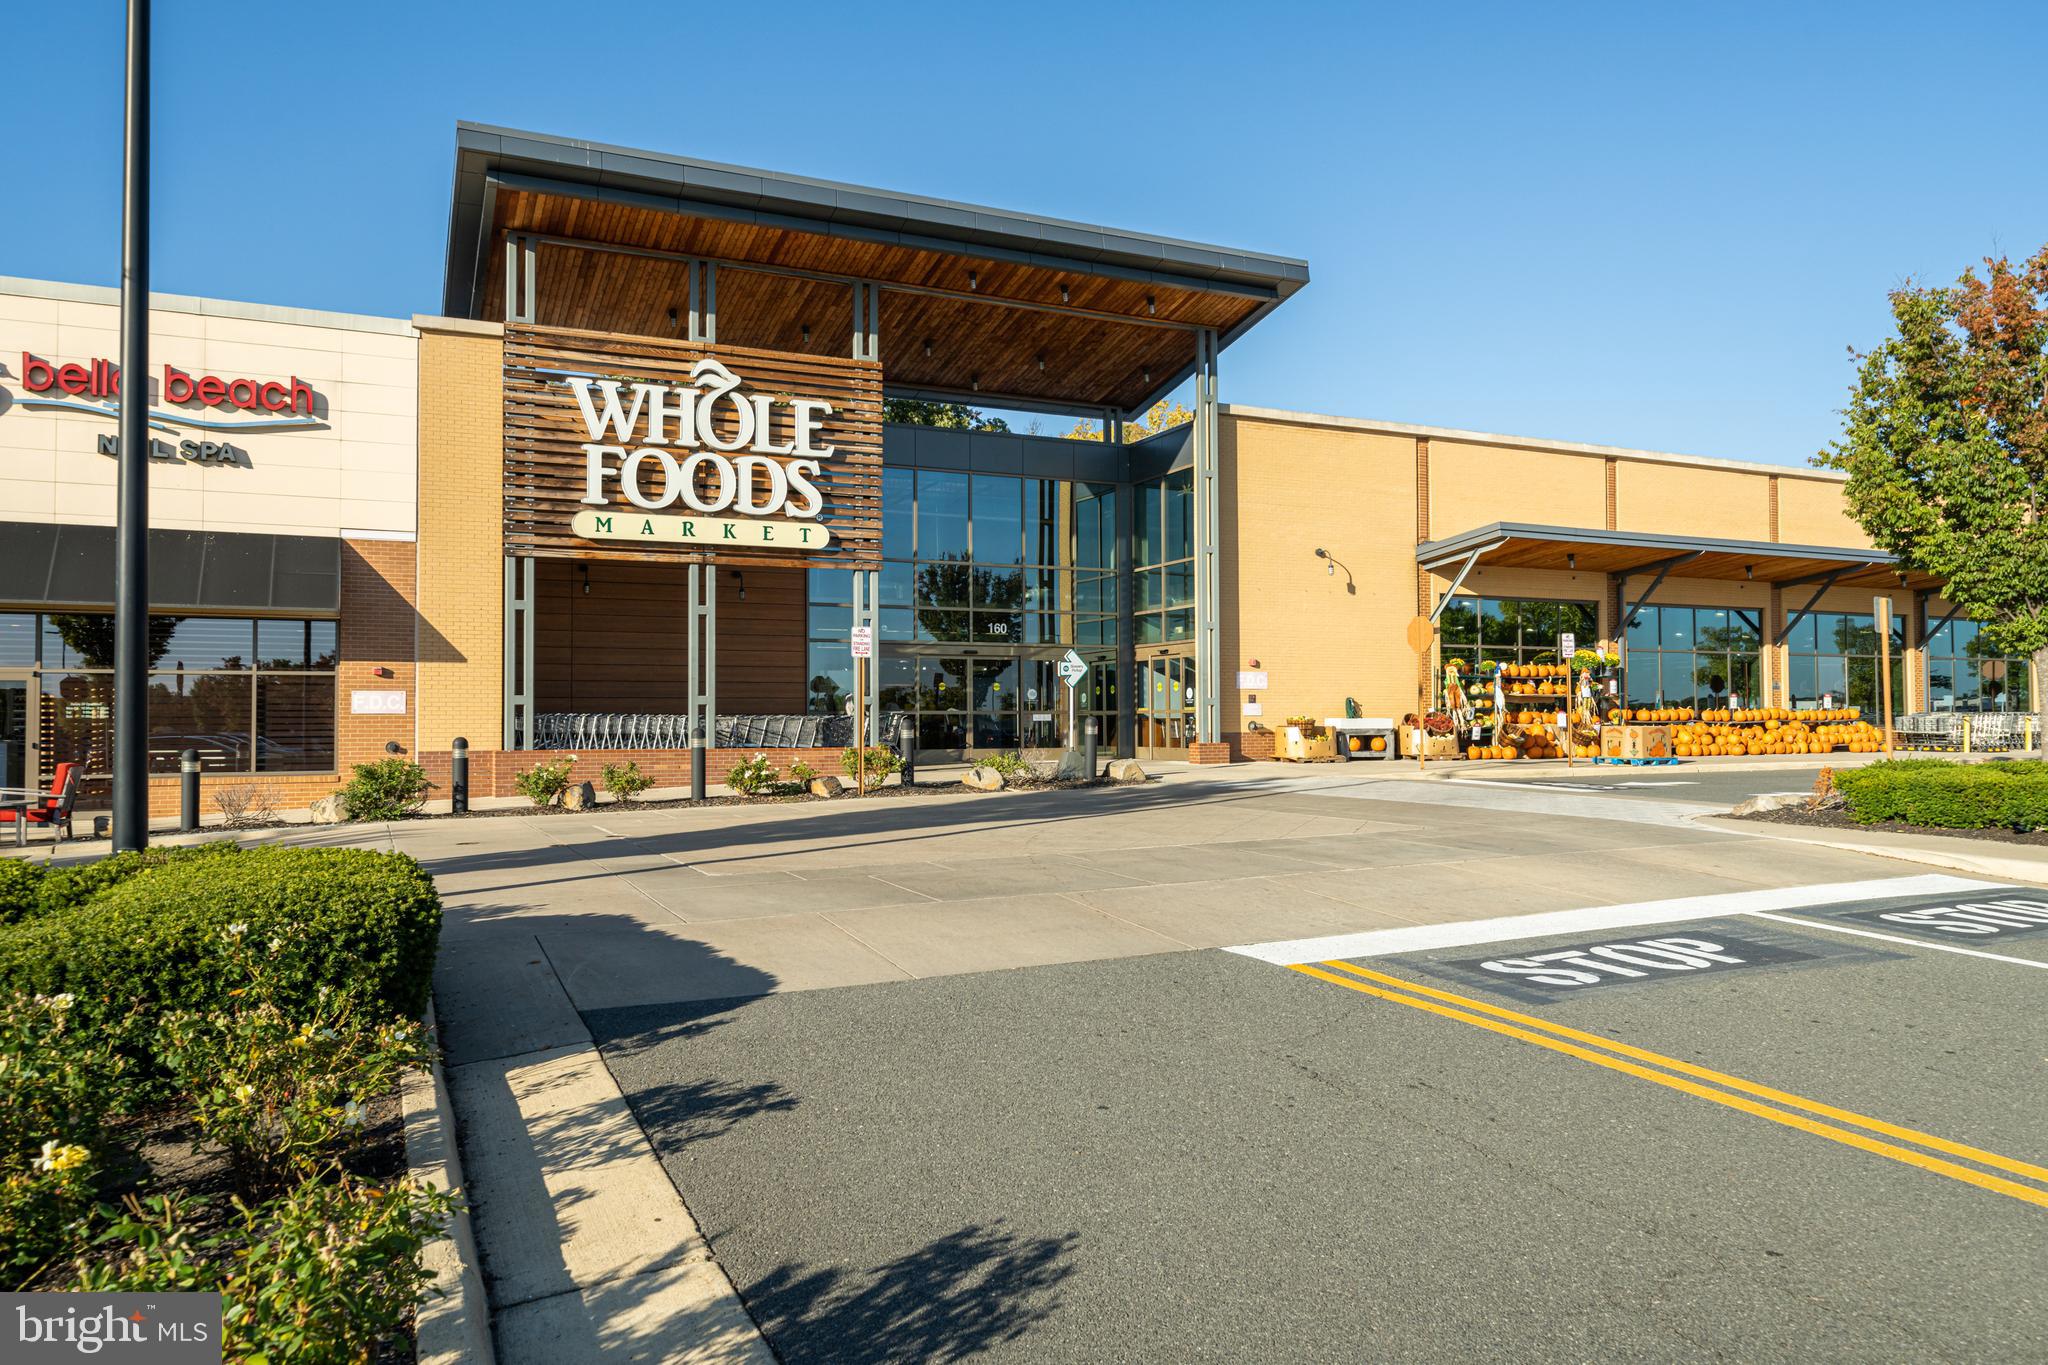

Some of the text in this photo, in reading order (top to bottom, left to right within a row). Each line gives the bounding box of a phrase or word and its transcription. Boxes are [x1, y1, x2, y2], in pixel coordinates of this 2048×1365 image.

[22, 351, 313, 414] bell beach
[566, 359, 835, 458] WHOLE
[97, 434, 236, 463] NL SPA
[581, 444, 823, 518] FOODS
[595, 516, 812, 543] MARKET
[987, 622, 1007, 634] 160
[1480, 938, 1747, 986] STOP
